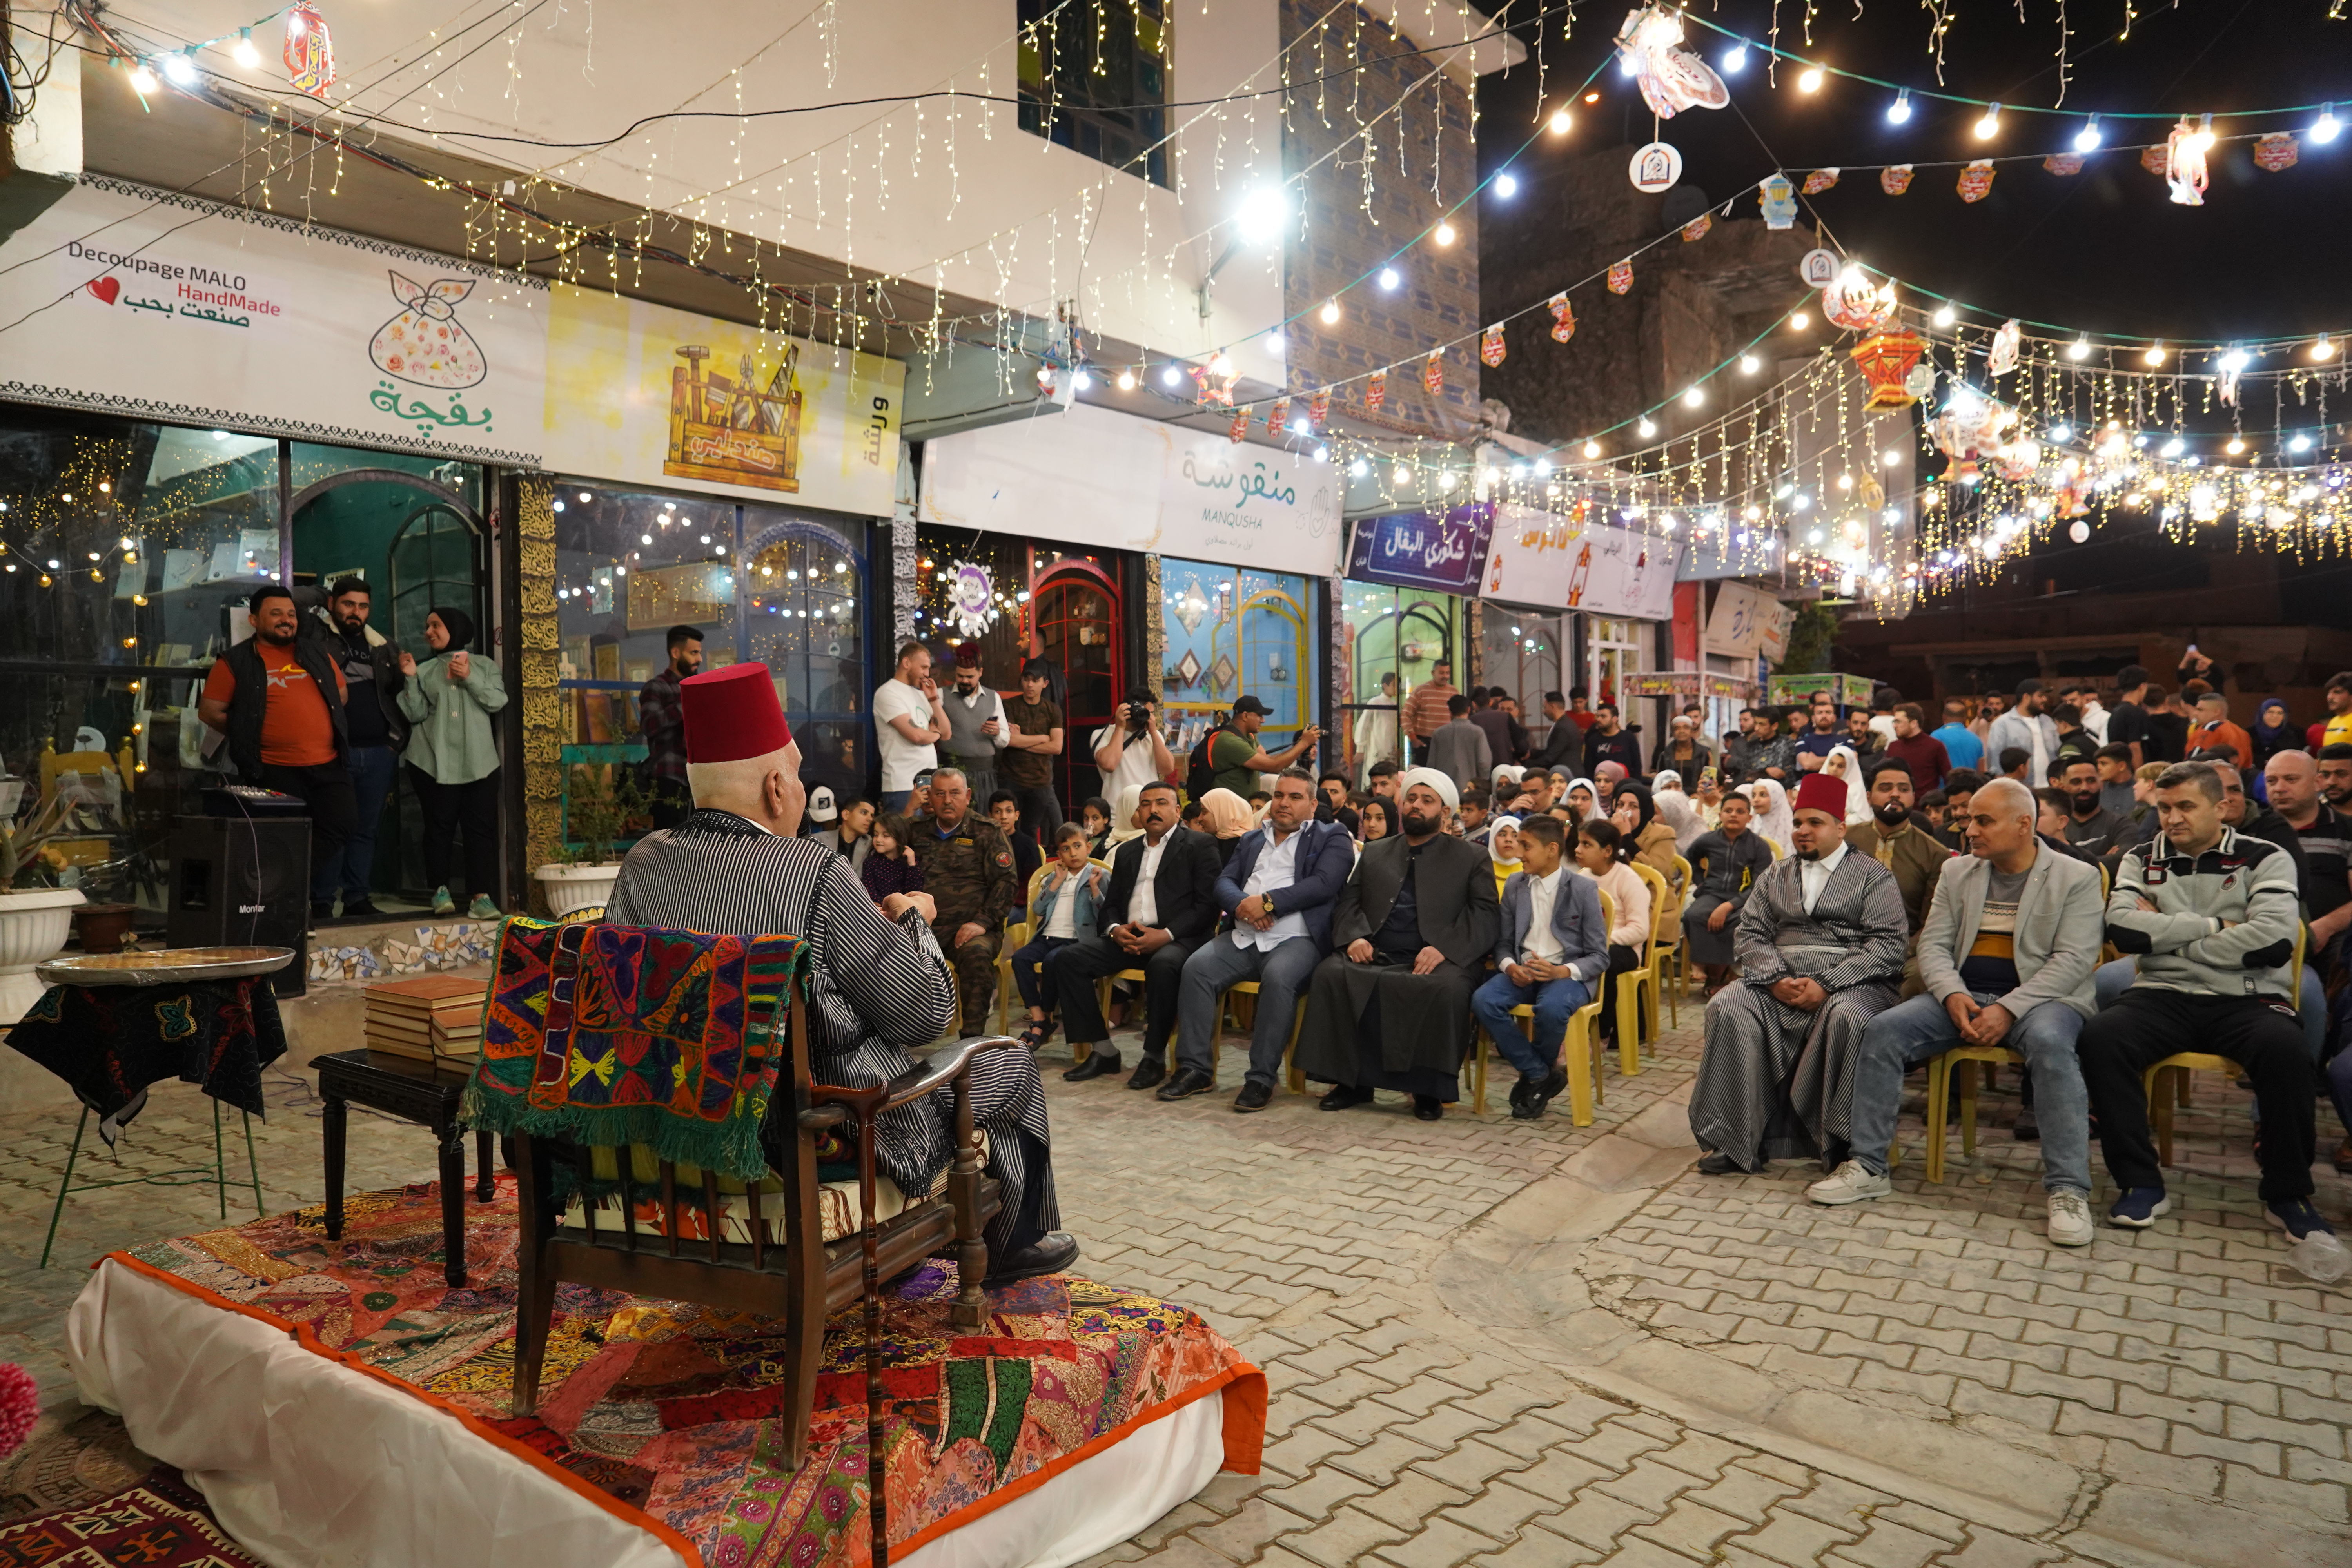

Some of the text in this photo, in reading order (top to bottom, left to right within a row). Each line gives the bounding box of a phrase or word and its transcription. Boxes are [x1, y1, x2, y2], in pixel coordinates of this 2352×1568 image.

[69, 241, 246, 290] Decoupage MALO
[123, 294, 250, 328] صنعت بحب
[178, 284, 281, 316] HandMade
[863, 396, 889, 466] ورشة
[1202, 508, 1263, 530] MANQUSHA
[1385, 526, 1465, 569] شكوري البقال
